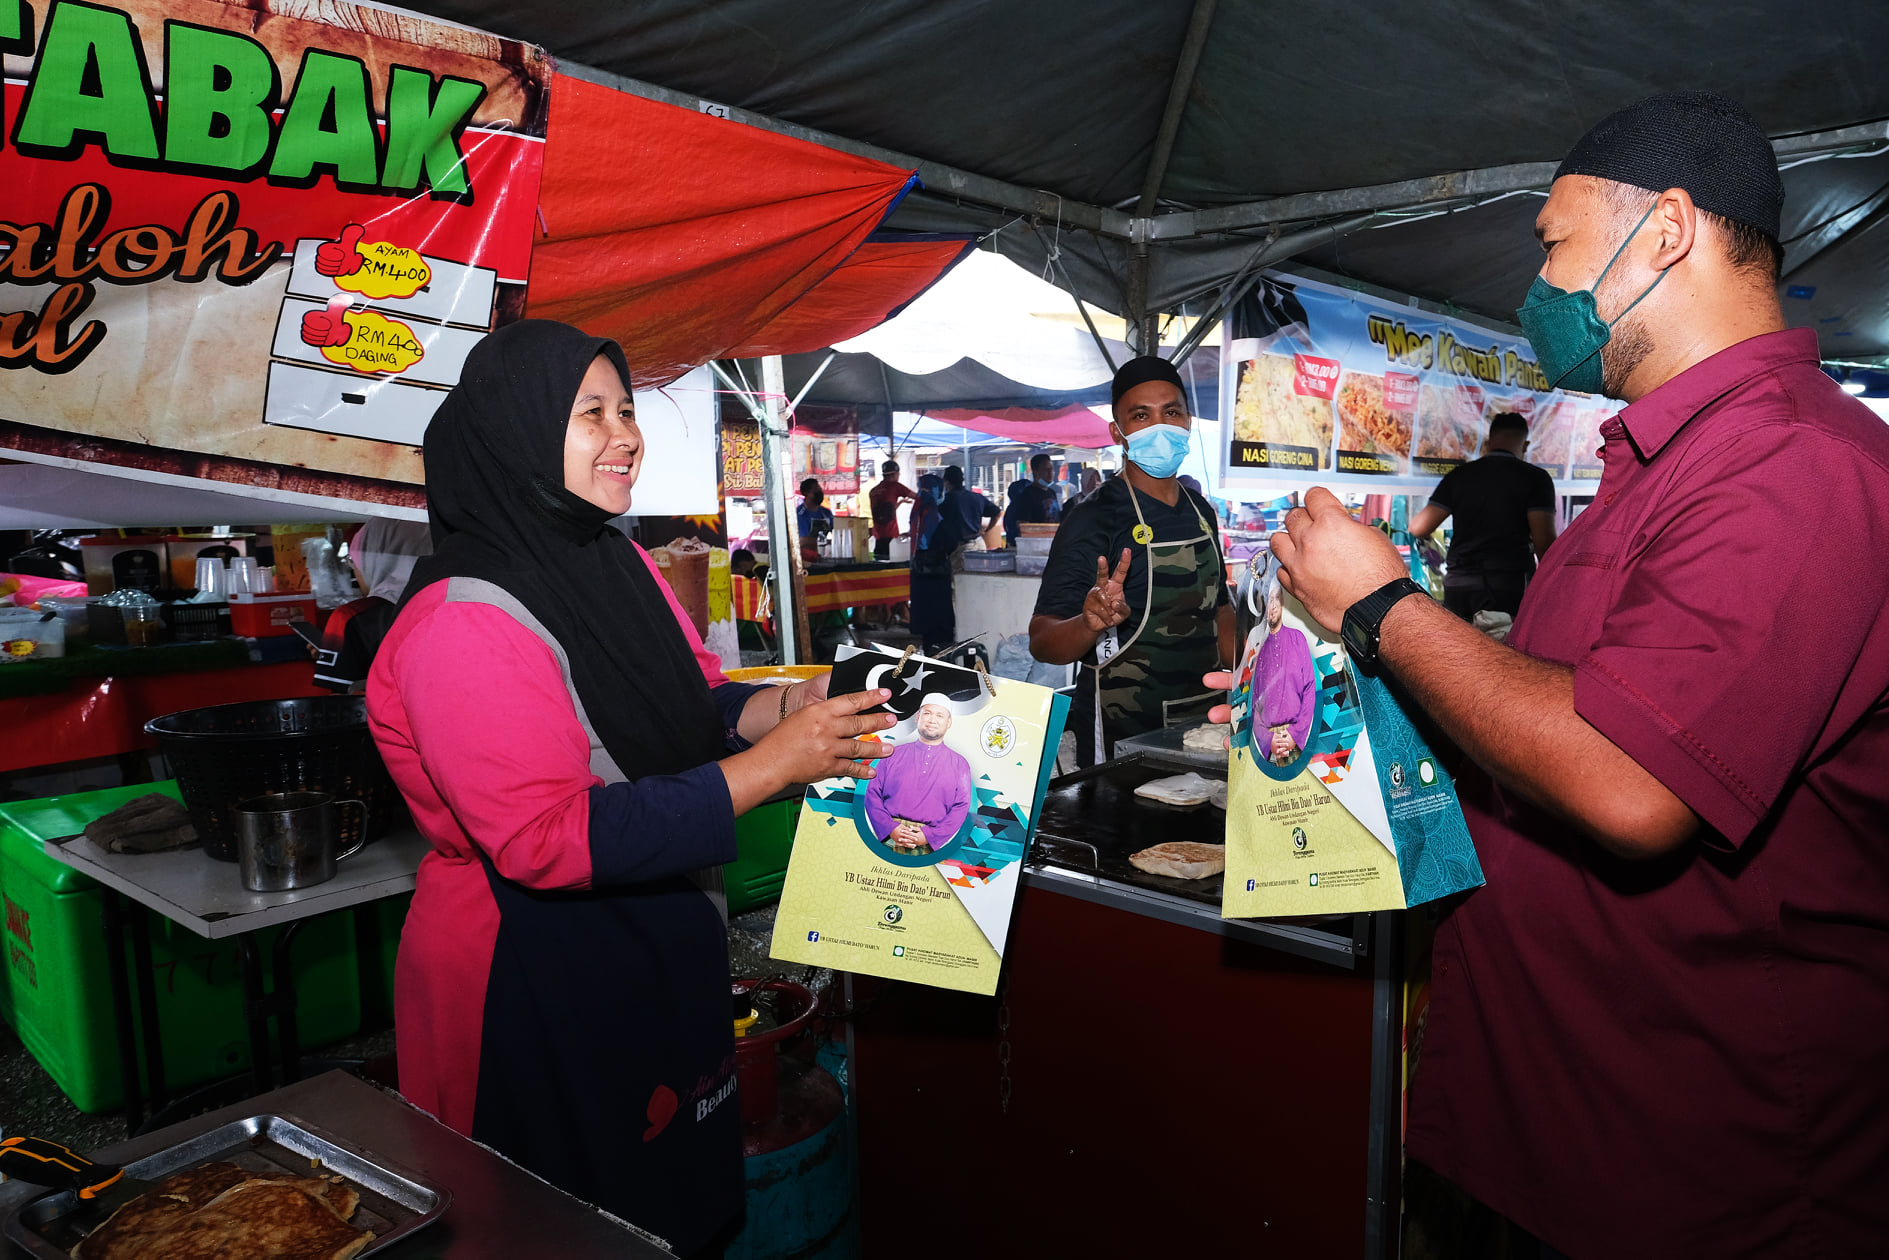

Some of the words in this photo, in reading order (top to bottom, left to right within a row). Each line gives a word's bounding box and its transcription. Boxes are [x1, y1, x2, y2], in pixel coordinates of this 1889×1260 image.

[0, 0, 485, 196] ABAK
[375, 244, 409, 258] AYAM
[345, 348, 398, 366] DAGING
[1242, 448, 1268, 462] NASI
[1270, 450, 1297, 464] GORENG
[1297, 451, 1314, 466] CINA
[1339, 456, 1354, 469] NASI
[1355, 457, 1379, 471] GORENG
[1291, 798, 1300, 810] Bin
[1313, 794, 1331, 805] Harun
[870, 866, 893, 876] Ikhlas
[895, 870, 930, 882] Daripada
[844, 872, 854, 882] YB
[857, 874, 874, 886] Ustaz
[876, 878, 896, 890] Hilmi
[897, 881, 909, 892] Bin
[930, 887, 951, 899] Harun
[890, 891, 914, 900] Undangan
